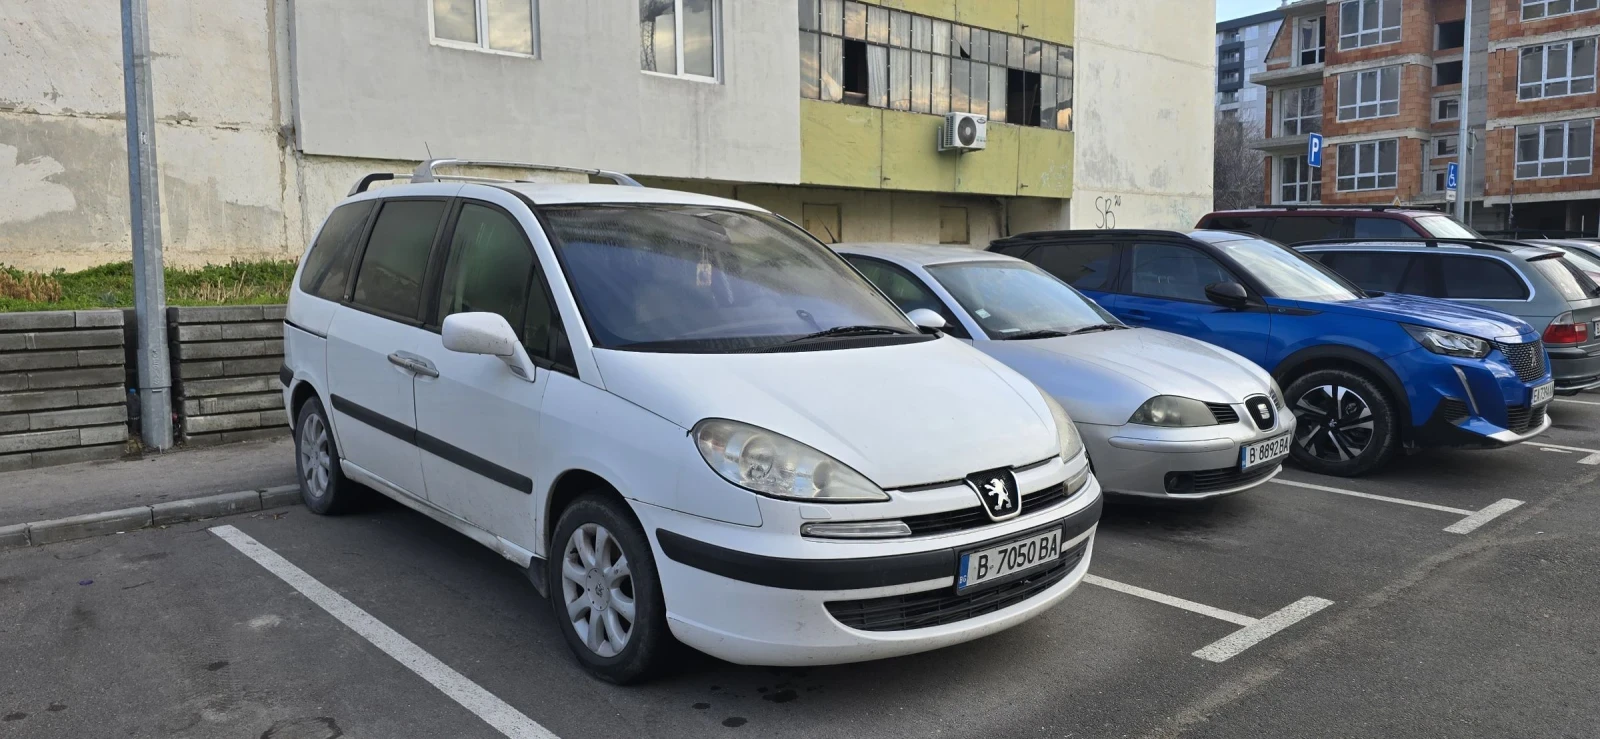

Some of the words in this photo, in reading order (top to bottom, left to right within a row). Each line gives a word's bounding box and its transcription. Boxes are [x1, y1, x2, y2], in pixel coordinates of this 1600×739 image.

[1311, 137, 1320, 162] P
[1250, 447, 1256, 464] B
[1259, 440, 1279, 460] 8892
[1279, 436, 1289, 454] BA
[977, 554, 989, 580] B
[996, 540, 1036, 574] 7050
[1038, 533, 1057, 561] BA
